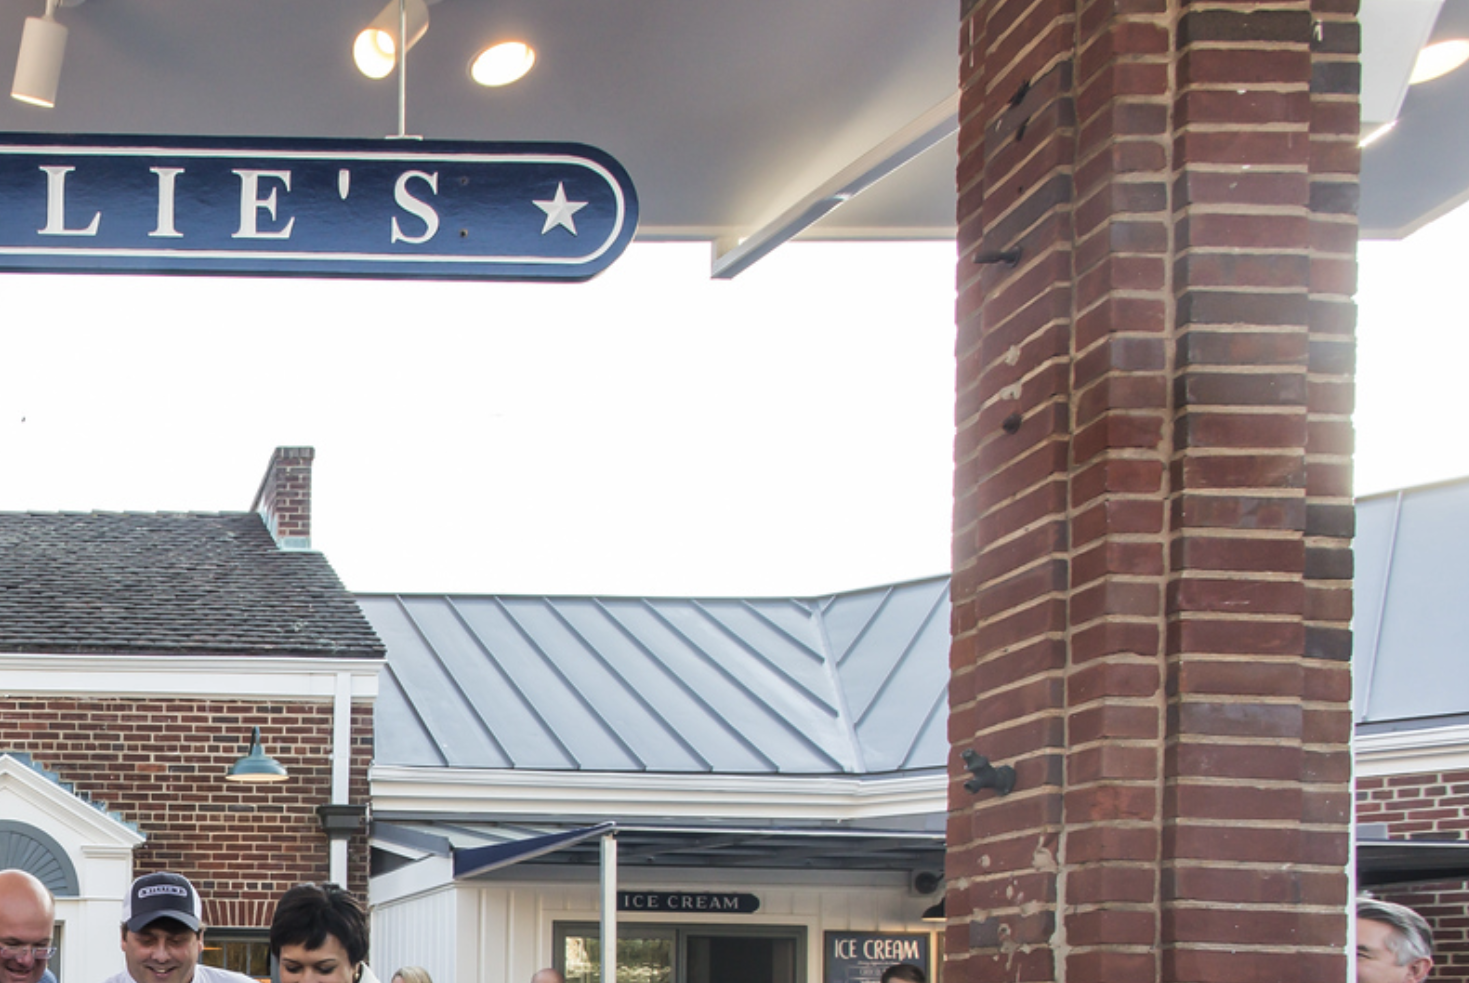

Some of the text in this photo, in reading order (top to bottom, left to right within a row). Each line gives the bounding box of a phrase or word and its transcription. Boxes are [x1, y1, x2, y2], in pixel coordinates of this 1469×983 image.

[624, 895, 739, 910] ICE CREAM
[835, 938, 920, 961] ICE CREAM
